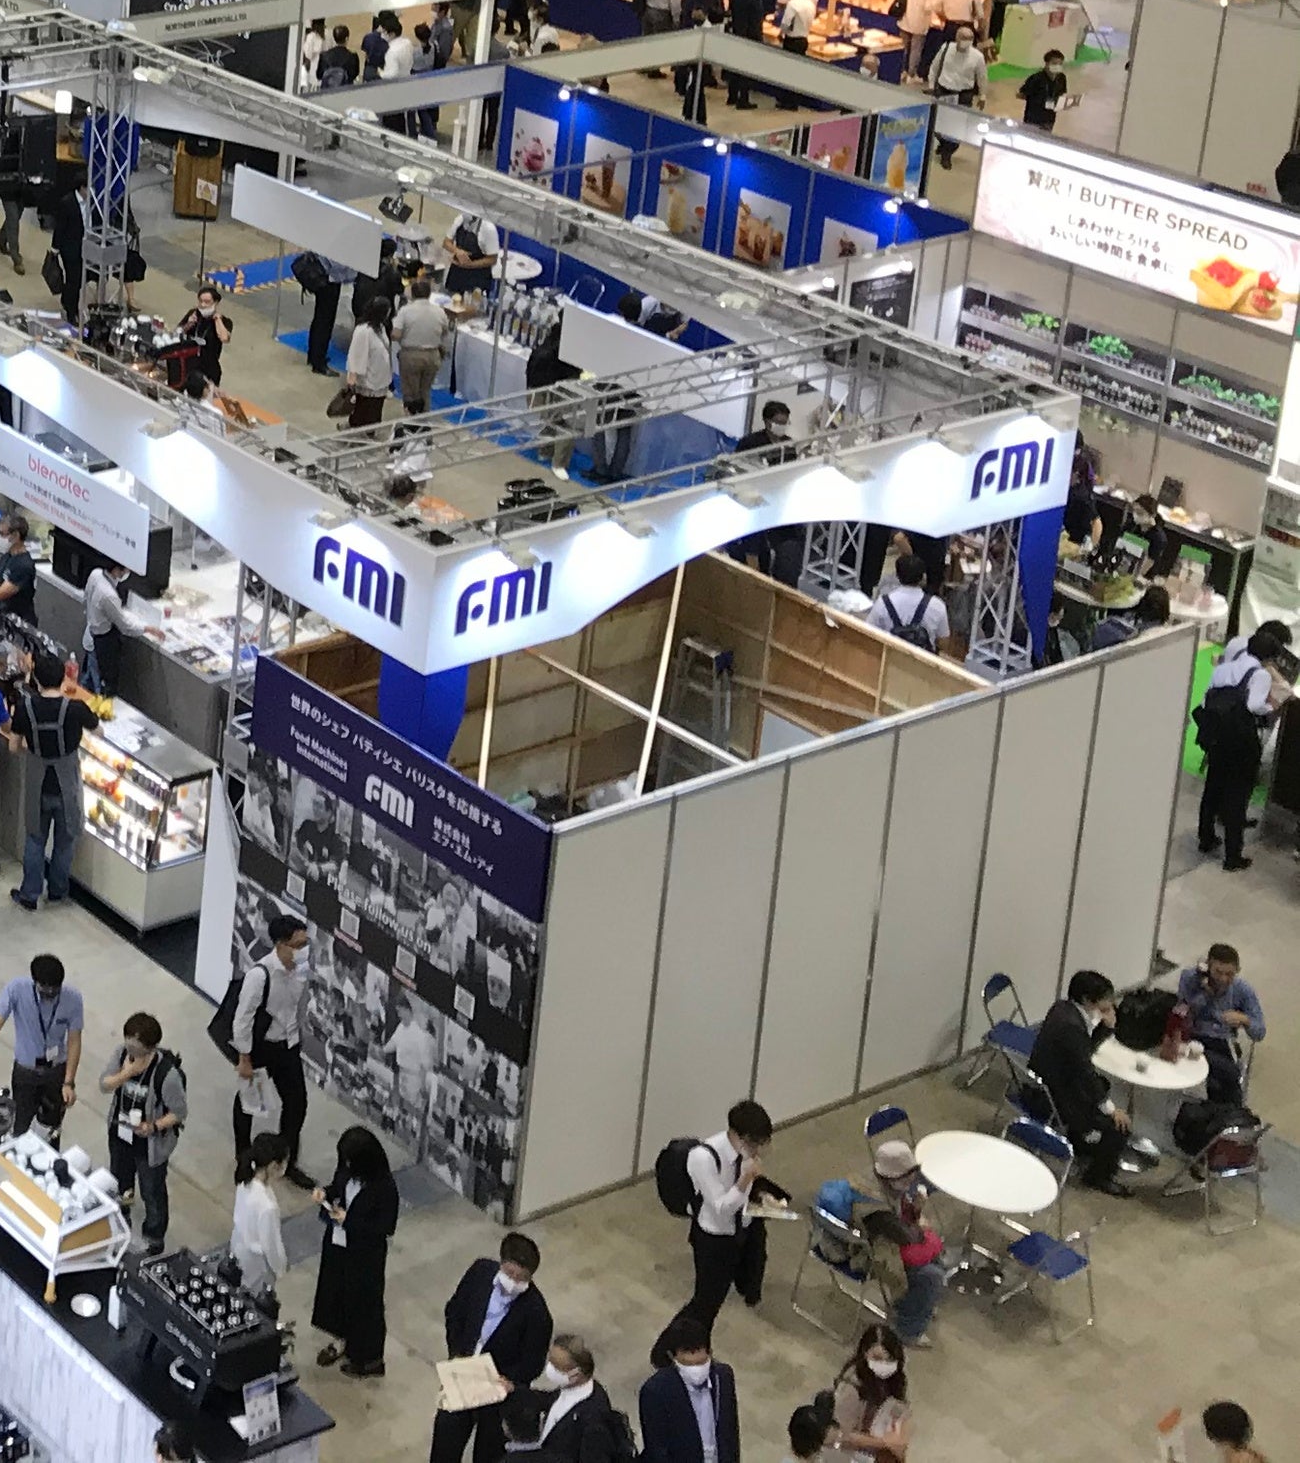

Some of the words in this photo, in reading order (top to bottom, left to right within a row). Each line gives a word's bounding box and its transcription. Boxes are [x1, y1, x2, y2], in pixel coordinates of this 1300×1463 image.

[1068, 214, 1161, 254] しあわせとろける
[1079, 185, 1160, 225] BUTTER
[1165, 213, 1249, 252] SPREAD
[1049, 224, 1174, 274] おいしい時間を食卓に
[27, 453, 90, 503] blendtec
[970, 438, 1055, 501] FMI
[313, 535, 406, 630] FMI
[454, 561, 553, 637] FMI
[290, 692, 351, 739] 世界のシェフ
[290, 725, 311, 747] Food
[311, 740, 348, 770] Machines
[296, 742, 348, 783] International
[364, 773, 416, 829] FMI
[433, 815, 471, 846] 株式会社
